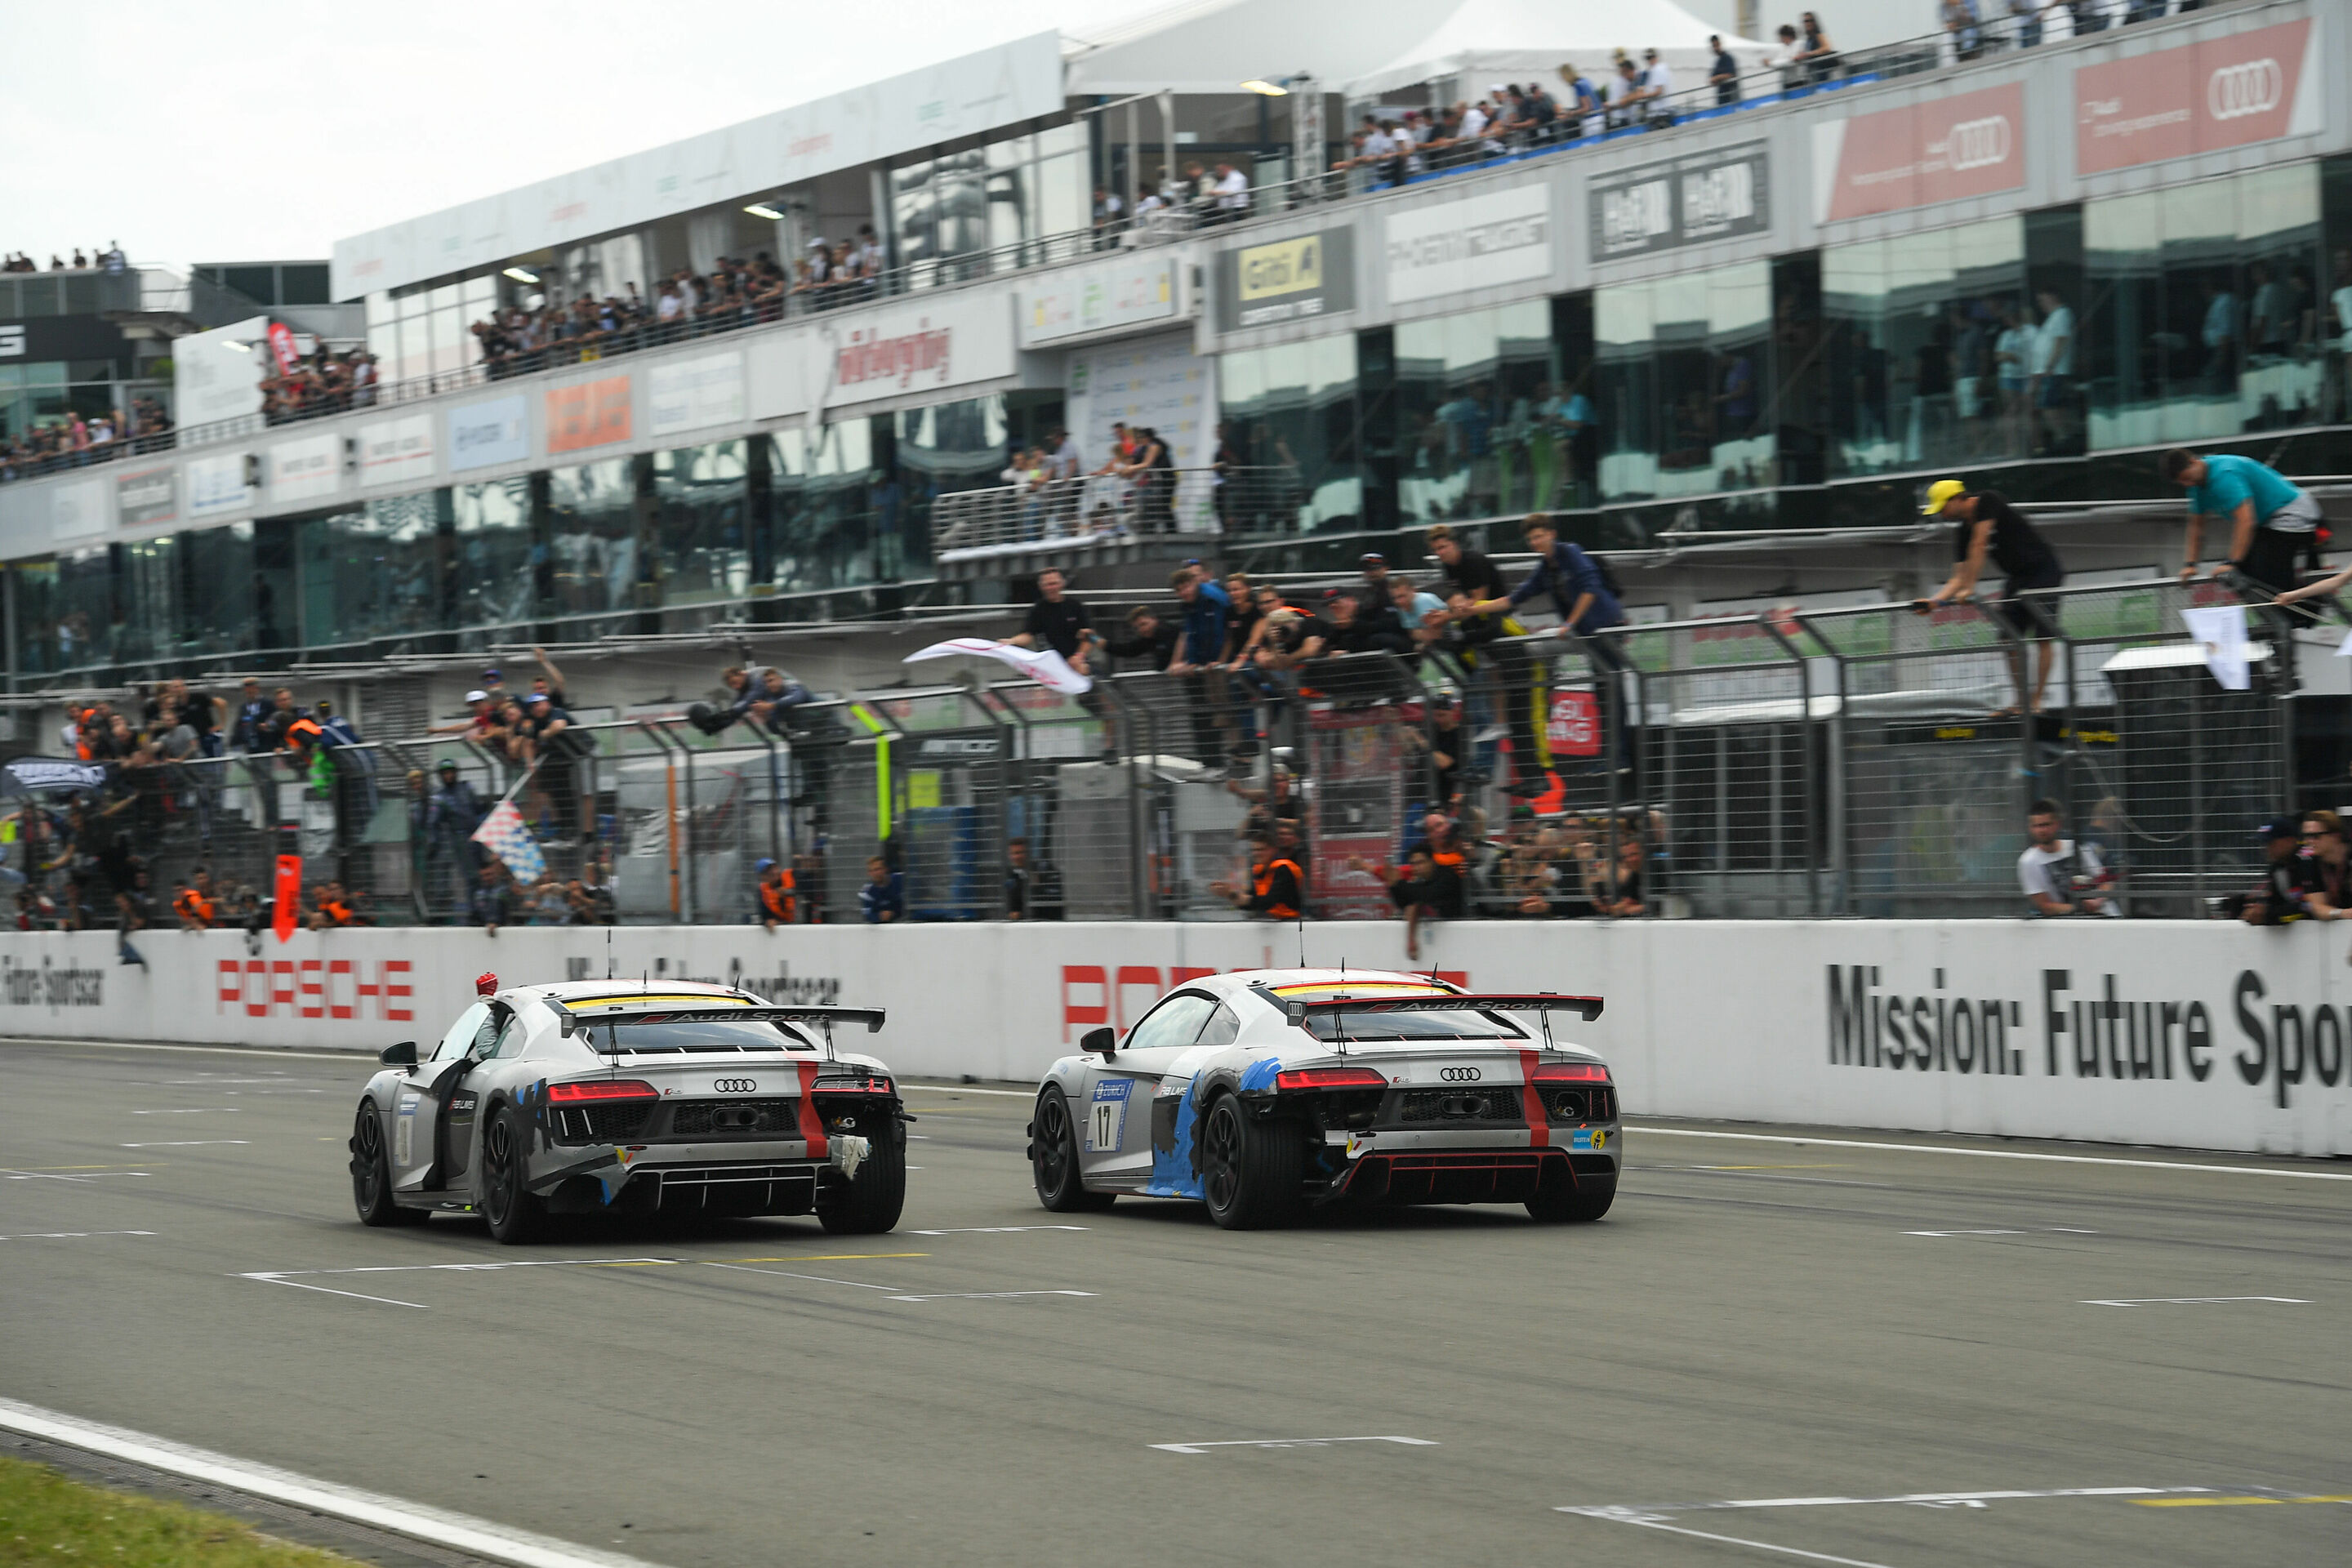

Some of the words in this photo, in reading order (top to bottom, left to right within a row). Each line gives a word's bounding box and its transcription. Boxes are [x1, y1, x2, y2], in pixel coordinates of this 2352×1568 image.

[216, 960, 415, 1022] PORSCHE
[1401, 1000, 1471, 1011] Audi
[1473, 1000, 1551, 1011] Sport
[675, 1012, 743, 1022] Audi
[749, 1012, 830, 1022] Sport
[1826, 964, 2025, 1076] Mission:
[2042, 969, 2216, 1082] Future
[2233, 969, 2352, 1109] Spo
[1097, 1105, 1111, 1147] 17
